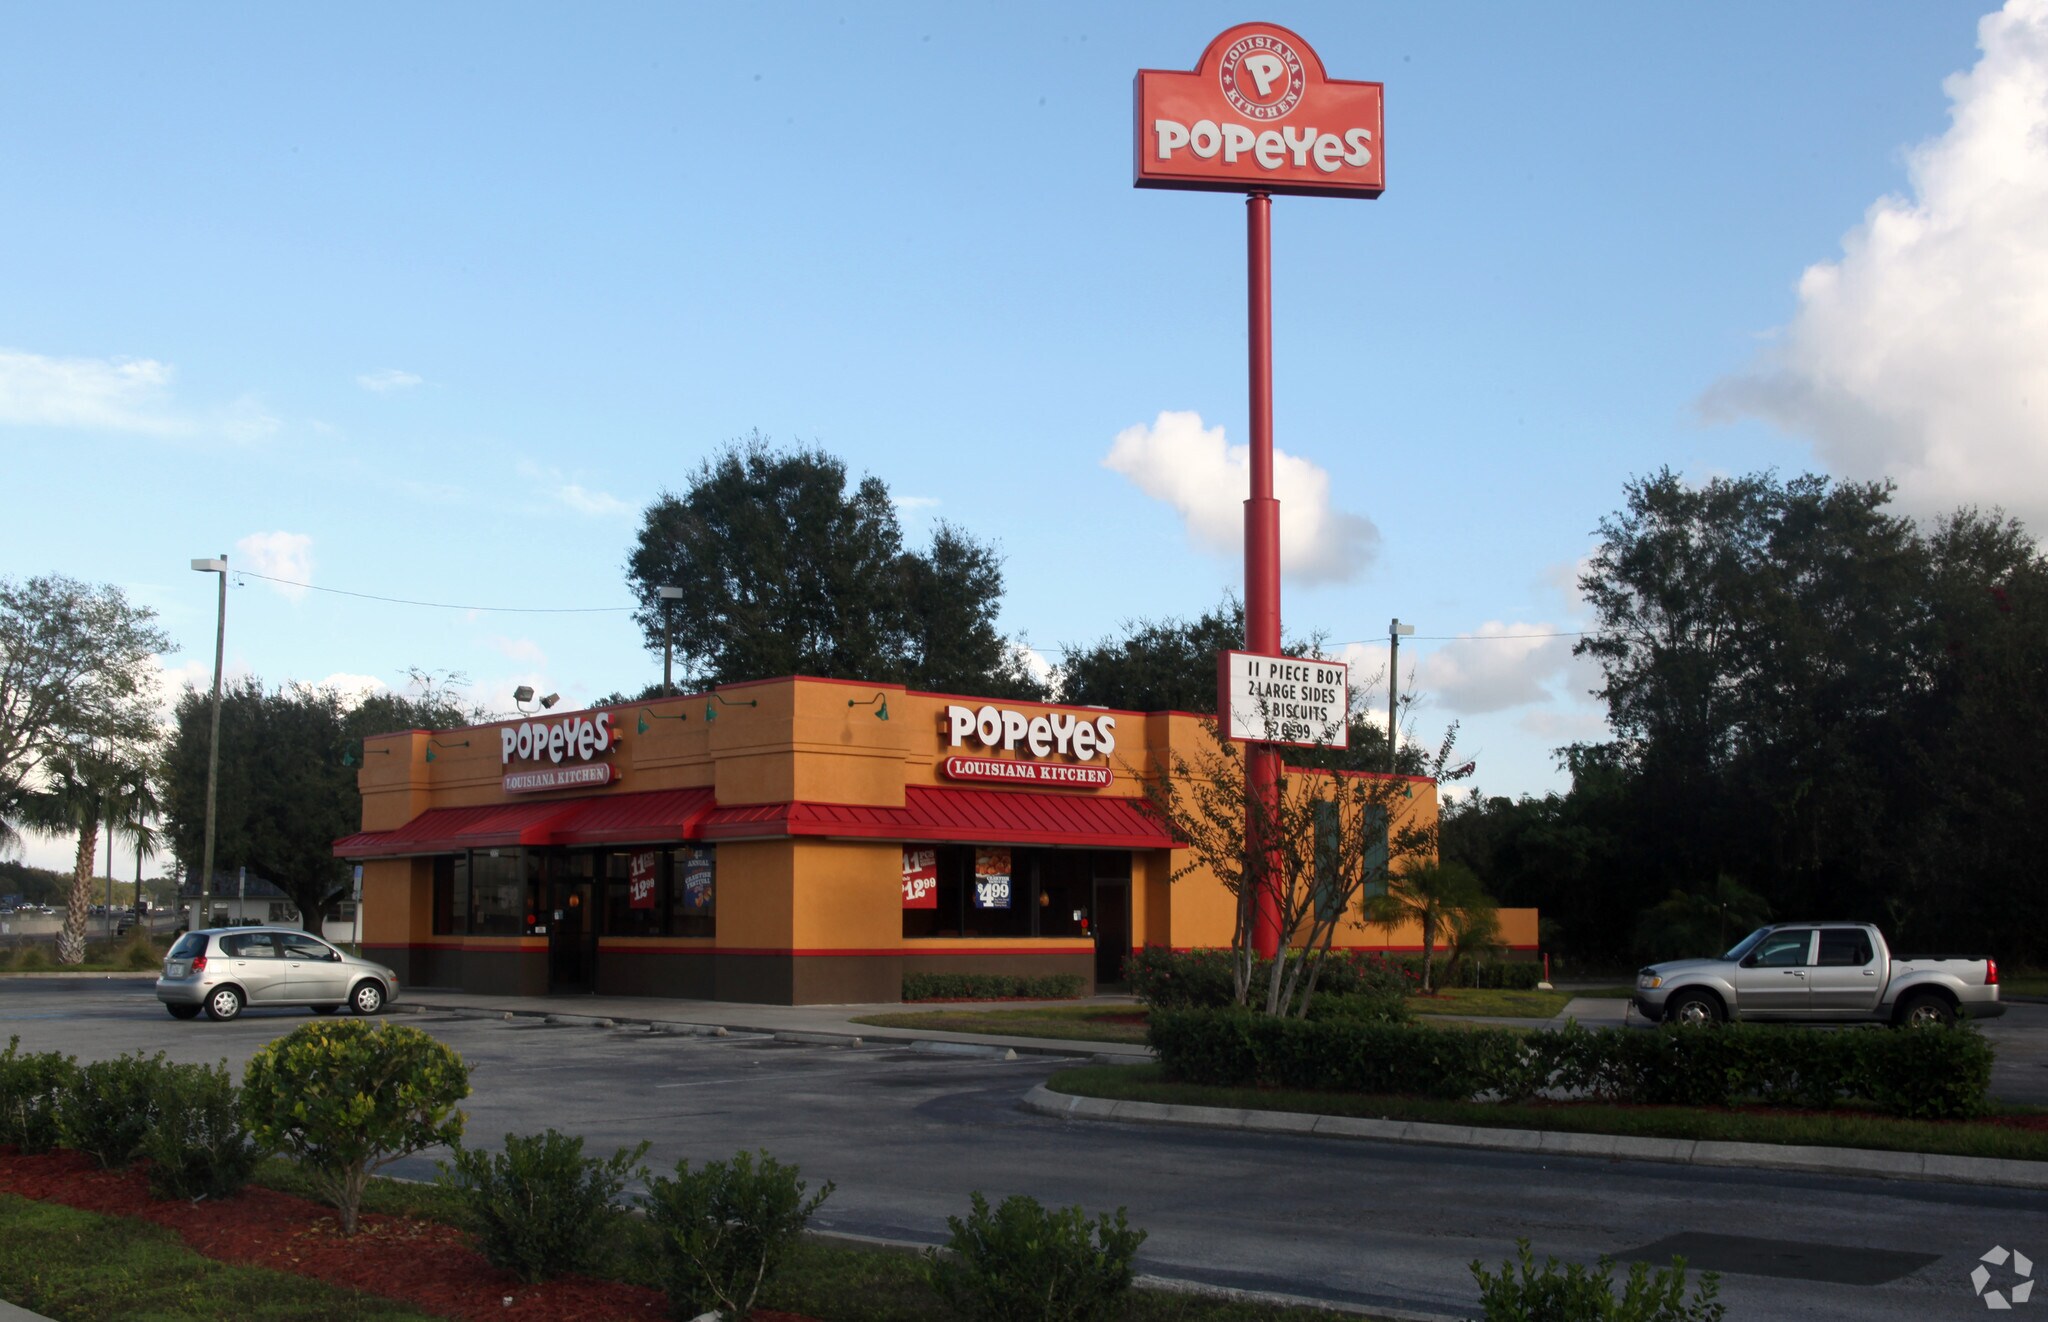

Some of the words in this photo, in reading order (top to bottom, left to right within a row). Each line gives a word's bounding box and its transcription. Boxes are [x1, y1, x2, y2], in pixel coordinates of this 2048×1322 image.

[1223, 37, 1300, 75] LOUISIANA
[1244, 54, 1284, 97] P
[1226, 88, 1298, 118] KITCHEN
[1248, 661, 1260, 677] 11
[1270, 663, 1309, 683] PIECE
[1317, 669, 1343, 686] BOX
[1248, 680, 1255, 696] 2
[1258, 682, 1297, 700] LARGE
[1301, 686, 1336, 704] SIDES
[1273, 702, 1328, 722] BISCUITS
[506, 774, 555, 790] LOUISIANA
[557, 768, 605, 784] KITCHEN
[955, 760, 1037, 779] LOUISIANA
[1040, 766, 1107, 784] KITCHEN
[902, 851, 923, 875] 11
